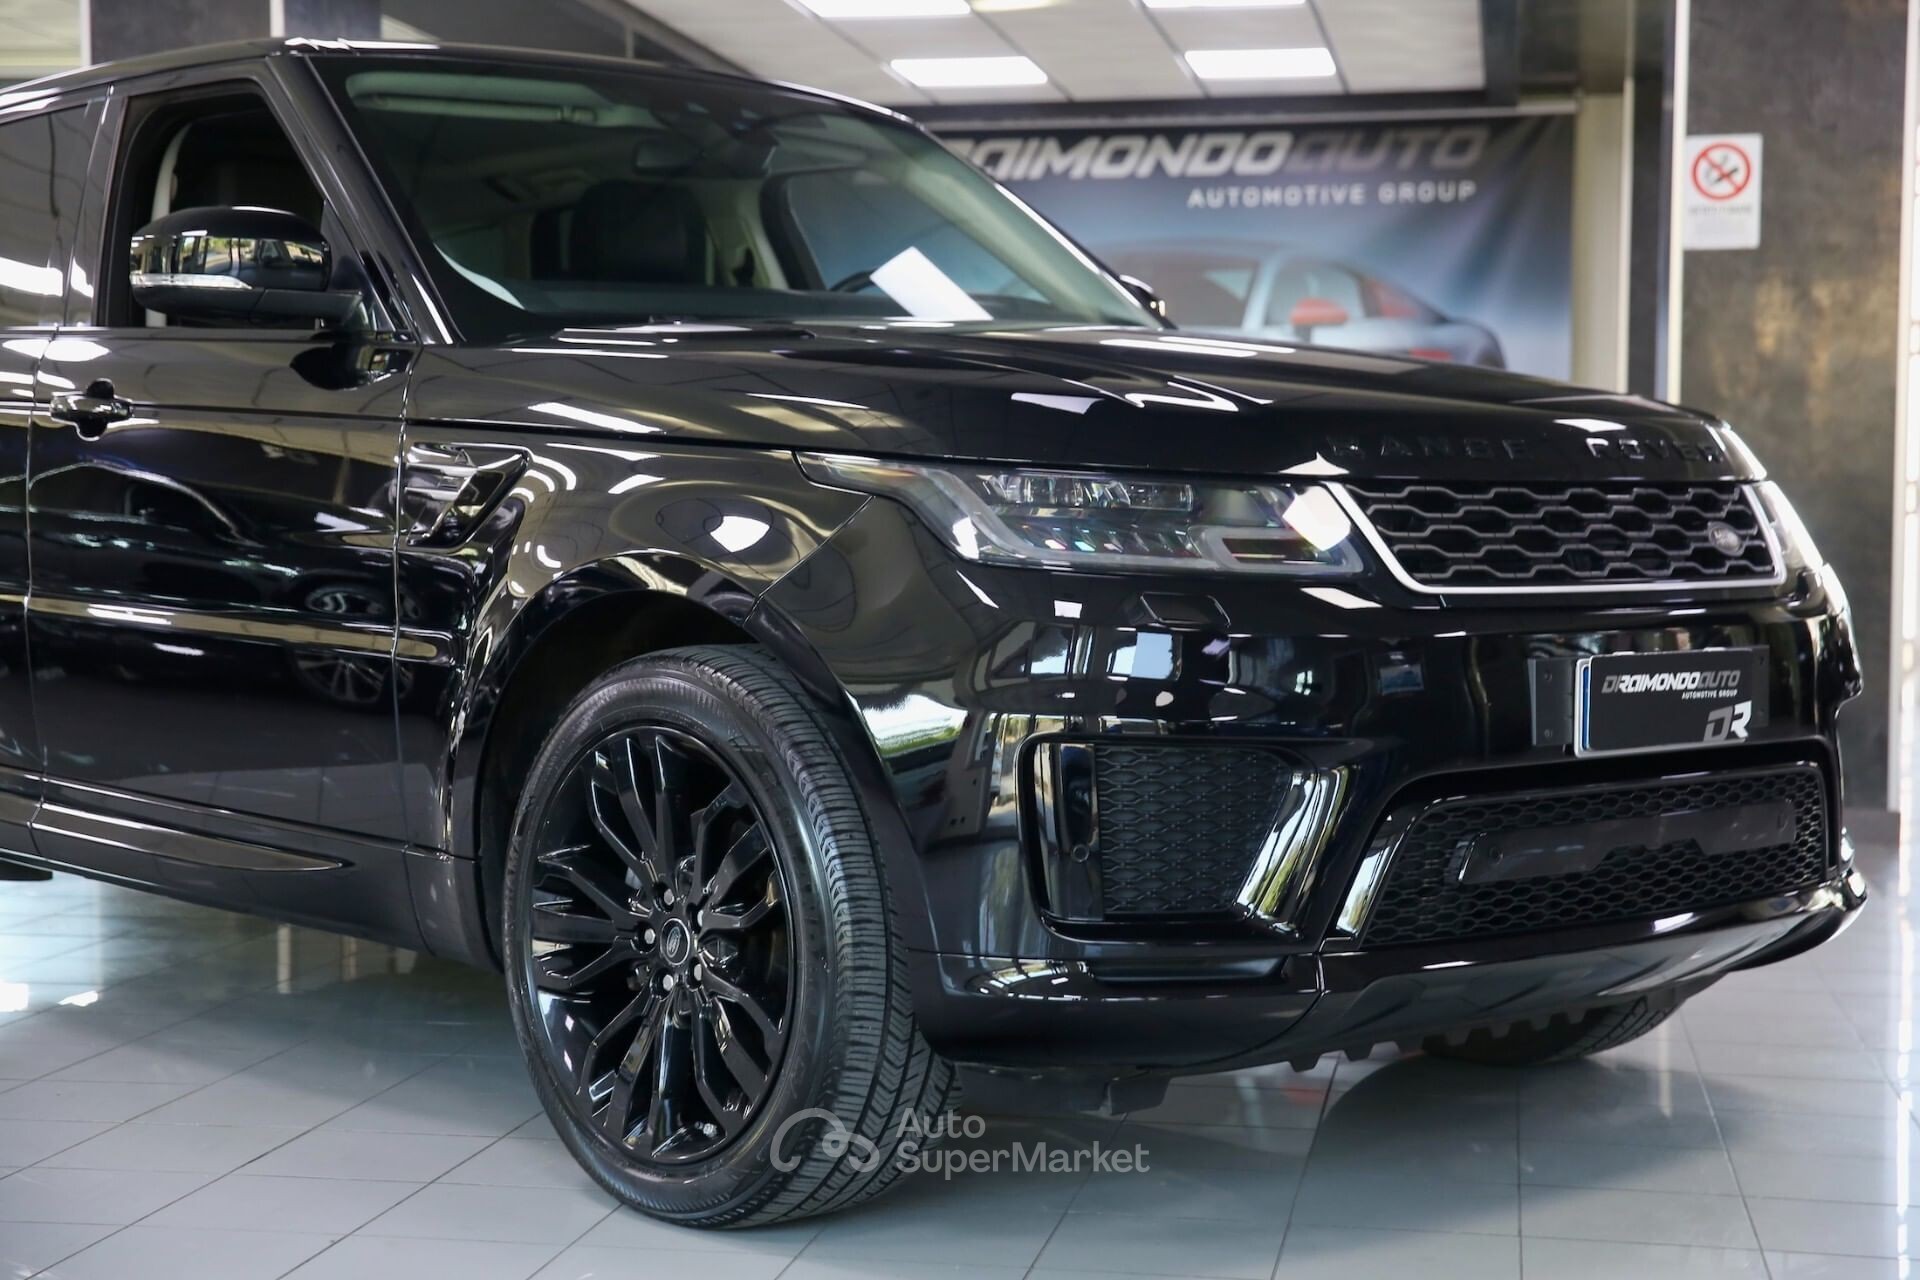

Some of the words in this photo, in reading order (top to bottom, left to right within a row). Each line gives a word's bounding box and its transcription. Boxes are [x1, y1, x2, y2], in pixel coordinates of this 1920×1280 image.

[1187, 184, 1366, 209] AUTOMOTIVE
[1378, 180, 1478, 203] GROUP
[1328, 435, 1533, 460] RANGE
[1681, 690, 1717, 699] AUTOMOTIVE
[1718, 689, 1738, 698] GROUP
[1703, 700, 1752, 743] DR
